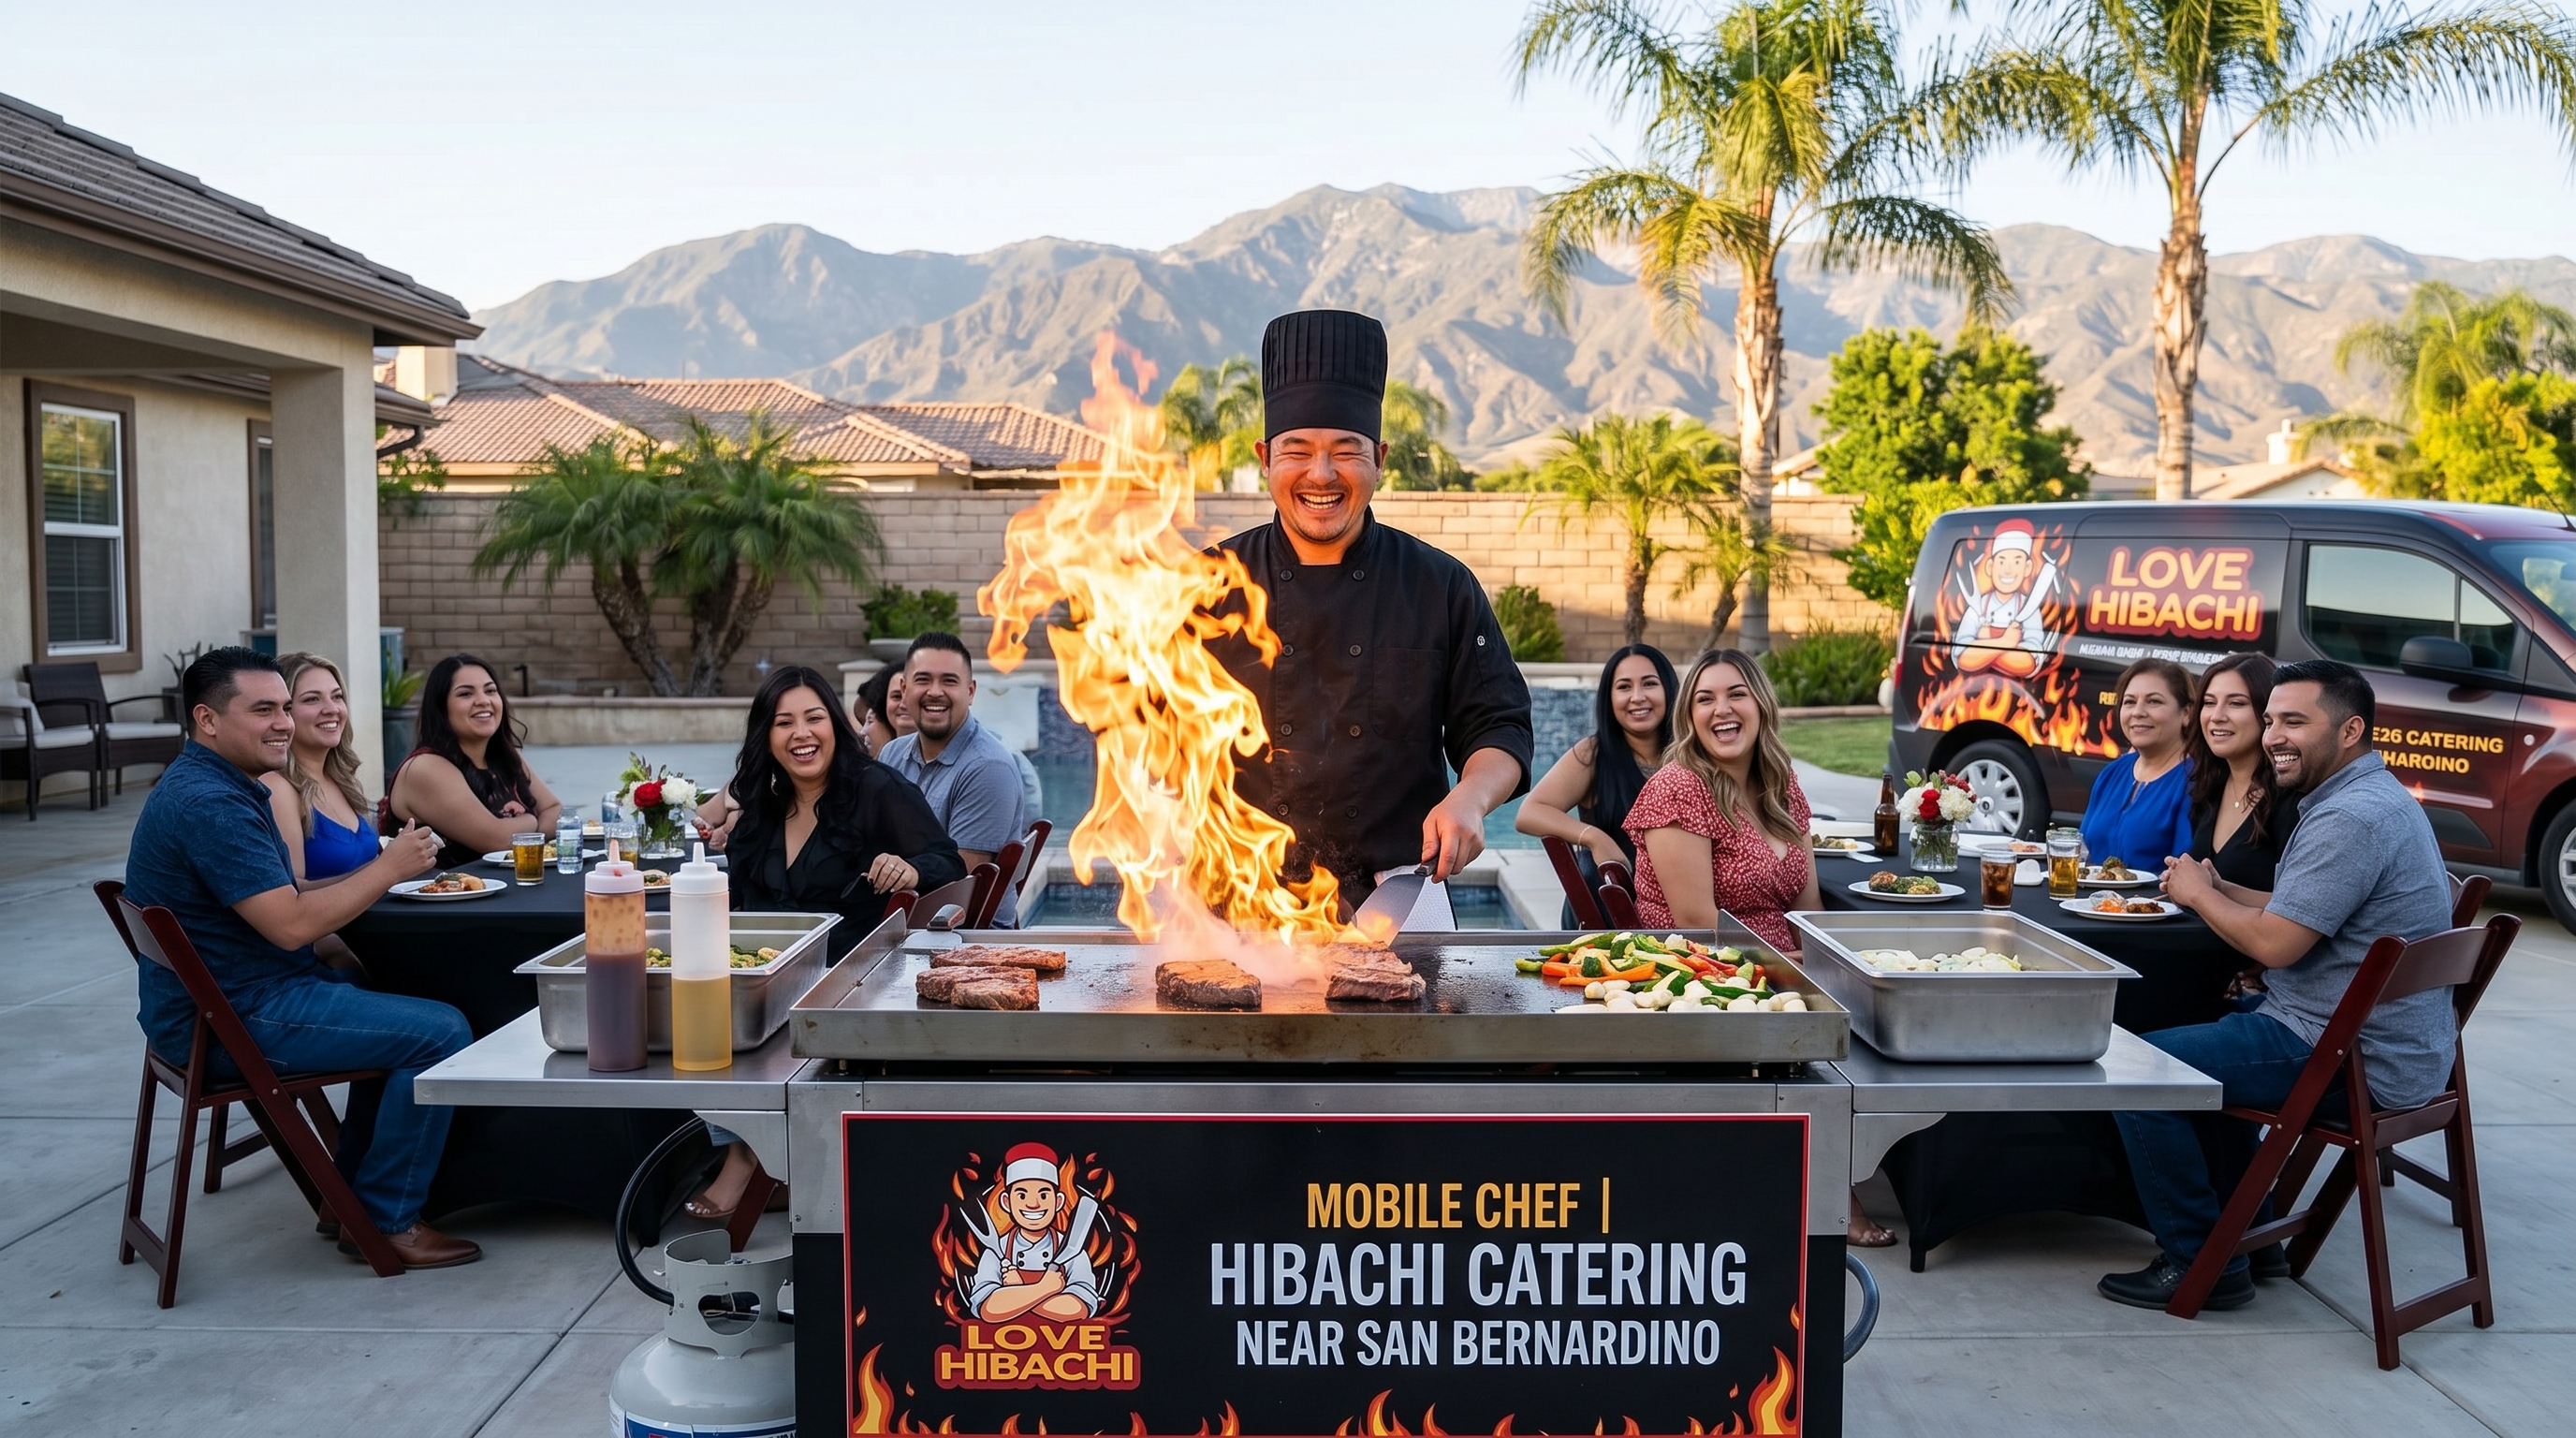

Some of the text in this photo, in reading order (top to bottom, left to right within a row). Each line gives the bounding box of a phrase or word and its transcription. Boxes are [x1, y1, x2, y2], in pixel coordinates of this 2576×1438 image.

[2111, 550, 2248, 591] LOVE
[2089, 589, 2259, 633] HIBACHI
[2378, 750, 2470, 774] HAROINO
[2406, 729, 2504, 754] CATERING
[1308, 1182, 1463, 1228] MOBILE
[1475, 1182, 1581, 1228] CHEF
[1211, 1242, 1747, 1306] HIBACHI CATERING
[968, 1324, 1105, 1350] LOVE
[1237, 1319, 1720, 1366] NEAR SAN BERNARDINO
[941, 1352, 1134, 1381] HIBACHI
